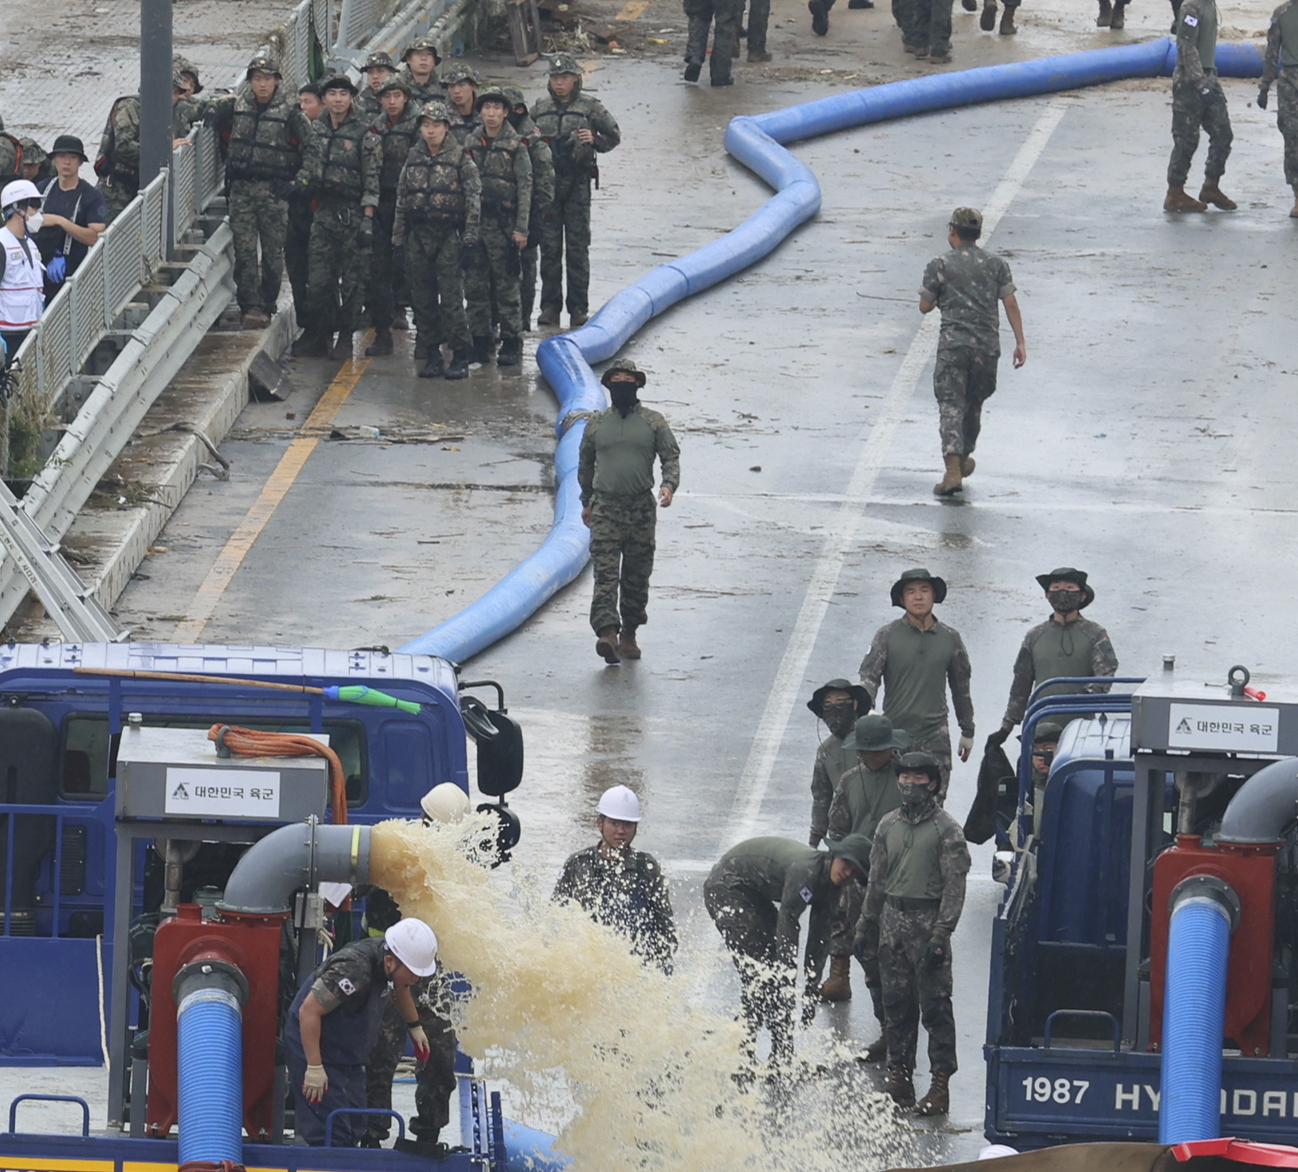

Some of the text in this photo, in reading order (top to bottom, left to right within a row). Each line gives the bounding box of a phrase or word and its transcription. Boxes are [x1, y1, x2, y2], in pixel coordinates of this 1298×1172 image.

[1197, 720, 1272, 736] 대한민국 육군
[195, 786, 274, 800] 대한민국 육군
[1022, 1076, 1090, 1105] 1987
